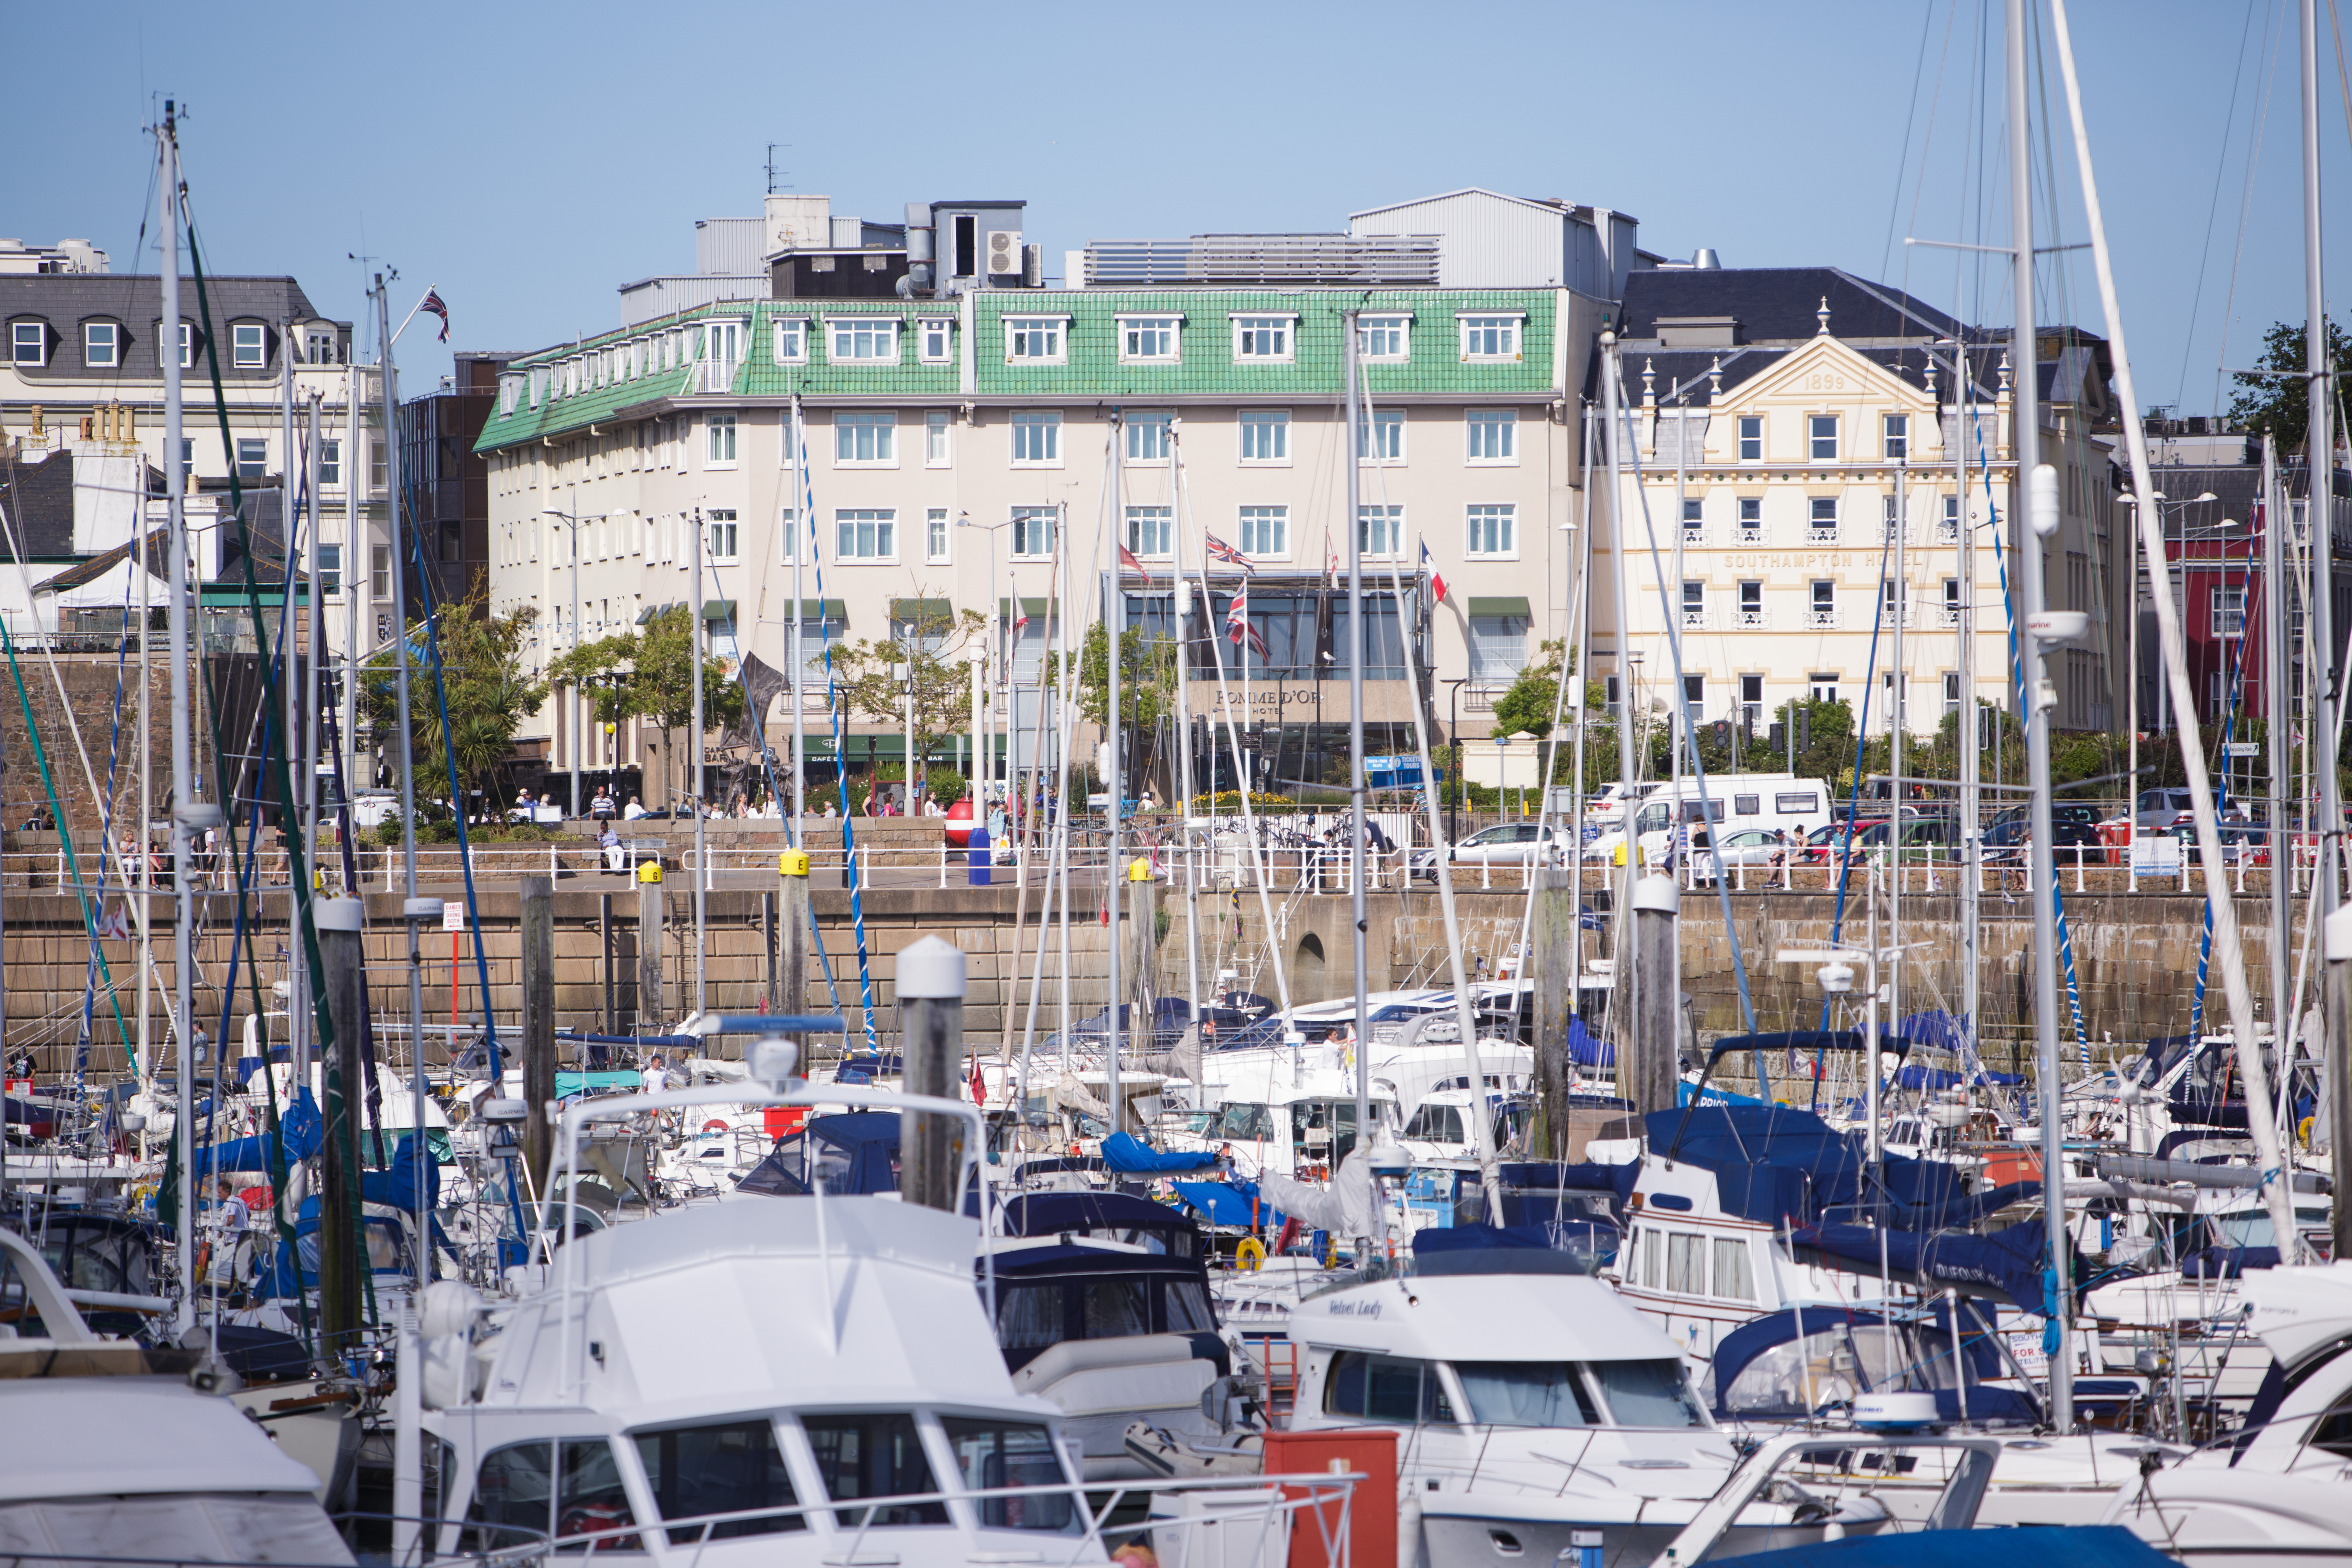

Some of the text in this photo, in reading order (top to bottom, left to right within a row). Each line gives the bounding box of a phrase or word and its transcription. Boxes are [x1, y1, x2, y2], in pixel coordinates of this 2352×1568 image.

[1805, 373, 1845, 390] 1899
[1724, 553, 1922, 568] SOUTHAMPTON HOTEL
[1216, 690, 1276, 704] POMME
[798, 860, 803, 870] E
[653, 872, 657, 880] G
[1330, 1299, 1383, 1321] Velvet Lady
[2013, 1348, 2034, 1358] FOR
